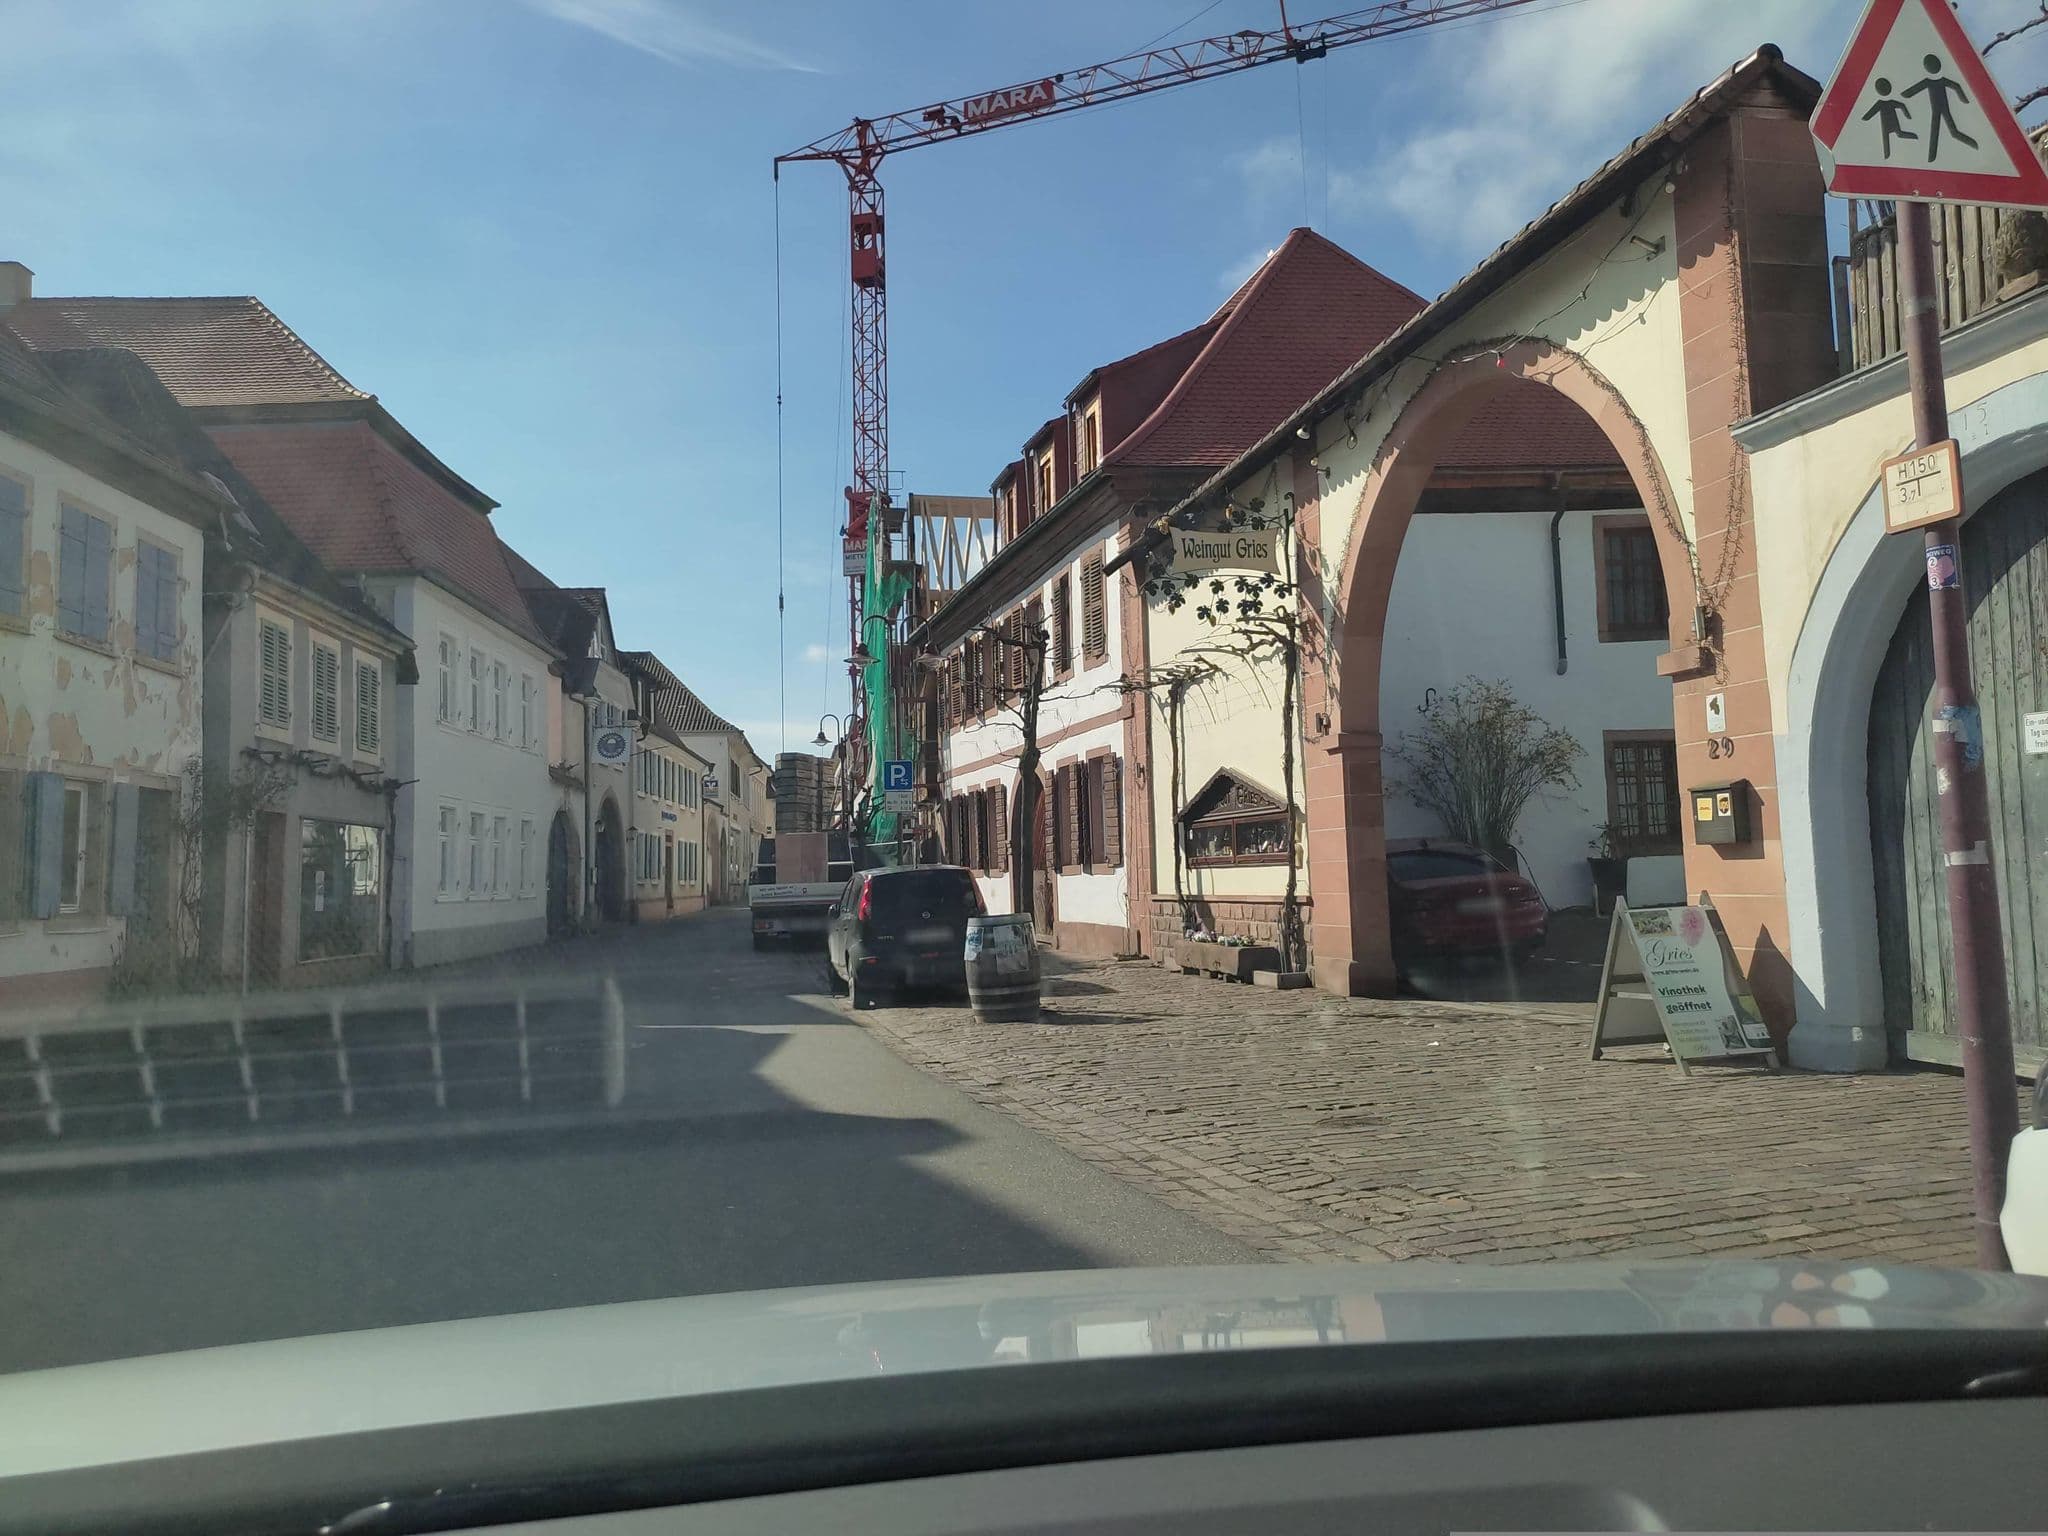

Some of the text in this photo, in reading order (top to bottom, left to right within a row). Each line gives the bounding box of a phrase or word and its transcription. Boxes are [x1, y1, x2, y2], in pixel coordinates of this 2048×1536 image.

[966, 84, 1049, 118] MARA
[1898, 454, 1936, 479] H150
[1899, 487, 1916, 503] 3,7
[1181, 537, 1268, 563] Weingut Gries
[1707, 736, 1735, 760] 29
[890, 764, 906, 787] P
[1645, 939, 1694, 968] Gries
[1658, 984, 1707, 997] Vinothek
[1665, 1001, 1712, 1015] geöffnet
